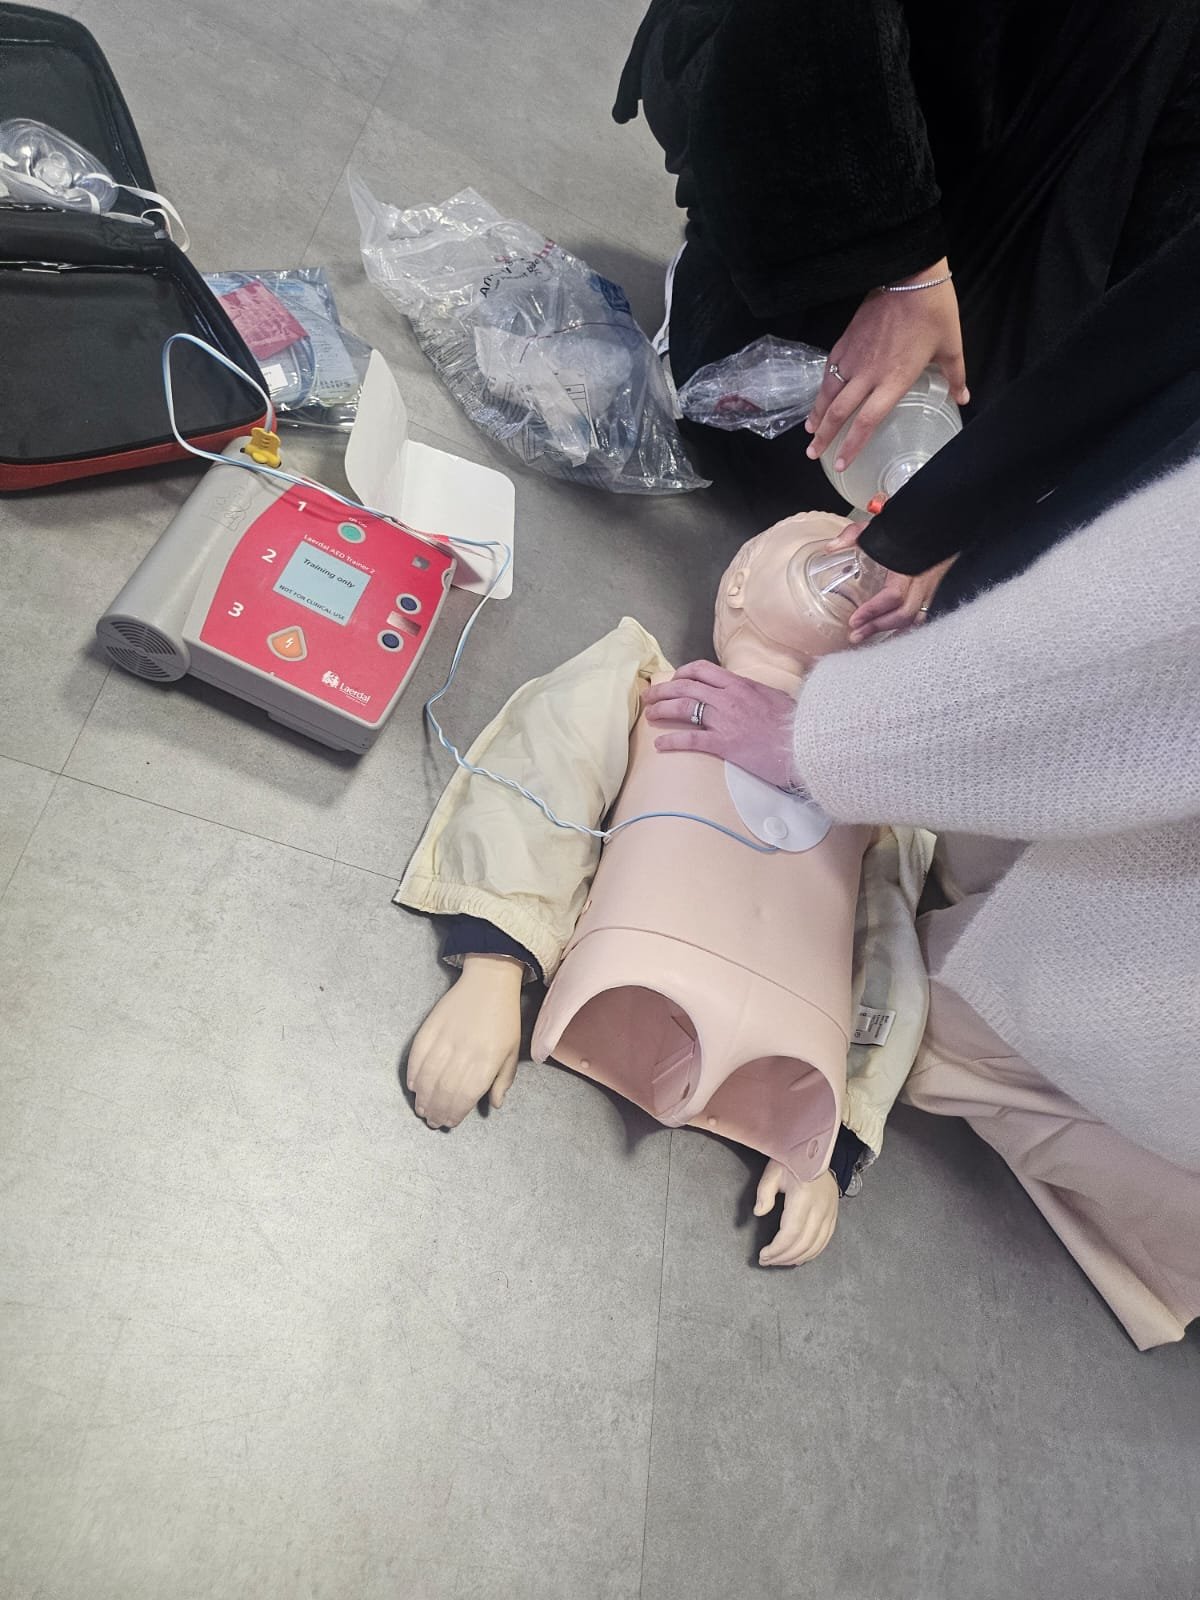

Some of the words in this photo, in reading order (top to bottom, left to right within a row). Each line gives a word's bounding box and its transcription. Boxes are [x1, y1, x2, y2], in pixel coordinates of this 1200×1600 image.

[296, 500, 307, 512] 1
[261, 548, 277, 564] 2
[303, 534, 330, 551] Laerdal
[330, 547, 346, 559] AED
[346, 556, 370, 572] Trainer
[303, 558, 336, 579] Training
[337, 576, 356, 589] only
[227, 601, 245, 618] 3
[279, 584, 293, 595] NOT
[293, 591, 306, 601] FOR
[306, 597, 333, 615] CLINICAL
[333, 610, 346, 621] USE
[339, 682, 371, 703] Laerdal
